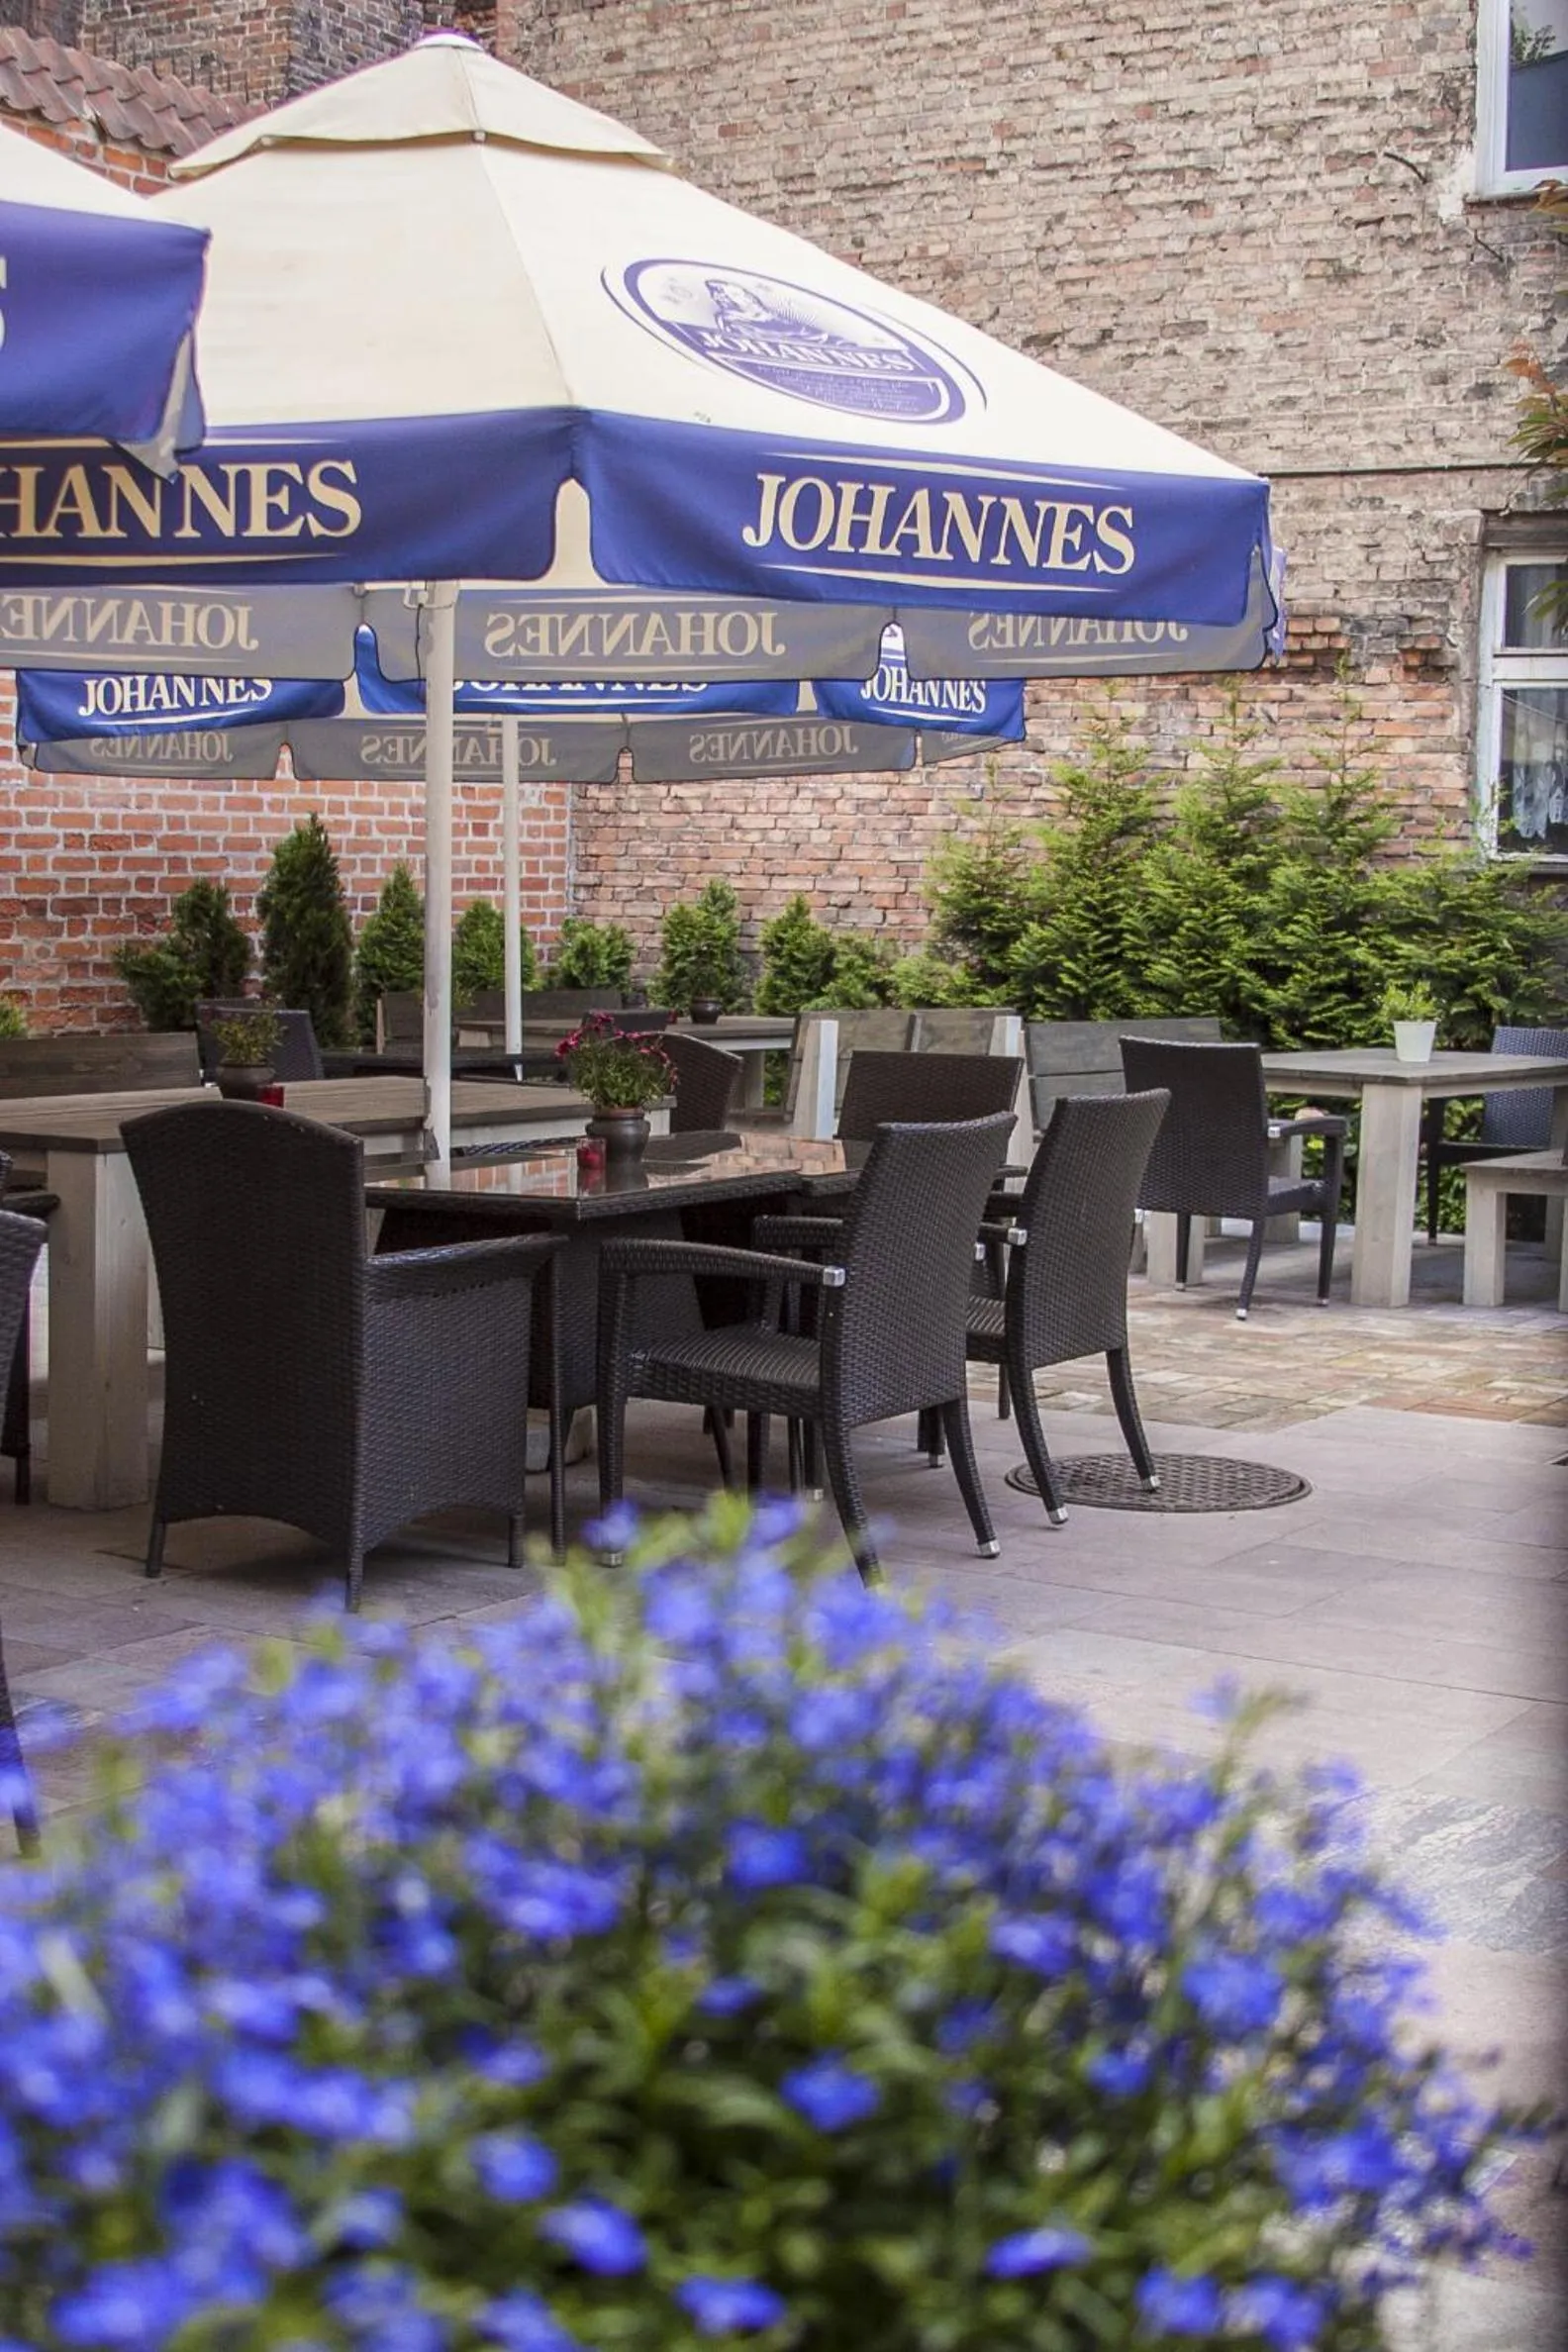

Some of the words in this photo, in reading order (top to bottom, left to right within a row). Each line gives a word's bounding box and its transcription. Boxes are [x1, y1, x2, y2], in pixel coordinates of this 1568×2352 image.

[702, 332, 915, 371] JOHANNES
[742, 473, 1134, 576] JOHANNES
[79, 675, 271, 716] JOHANNES
[861, 665, 986, 714] JOHANNES
